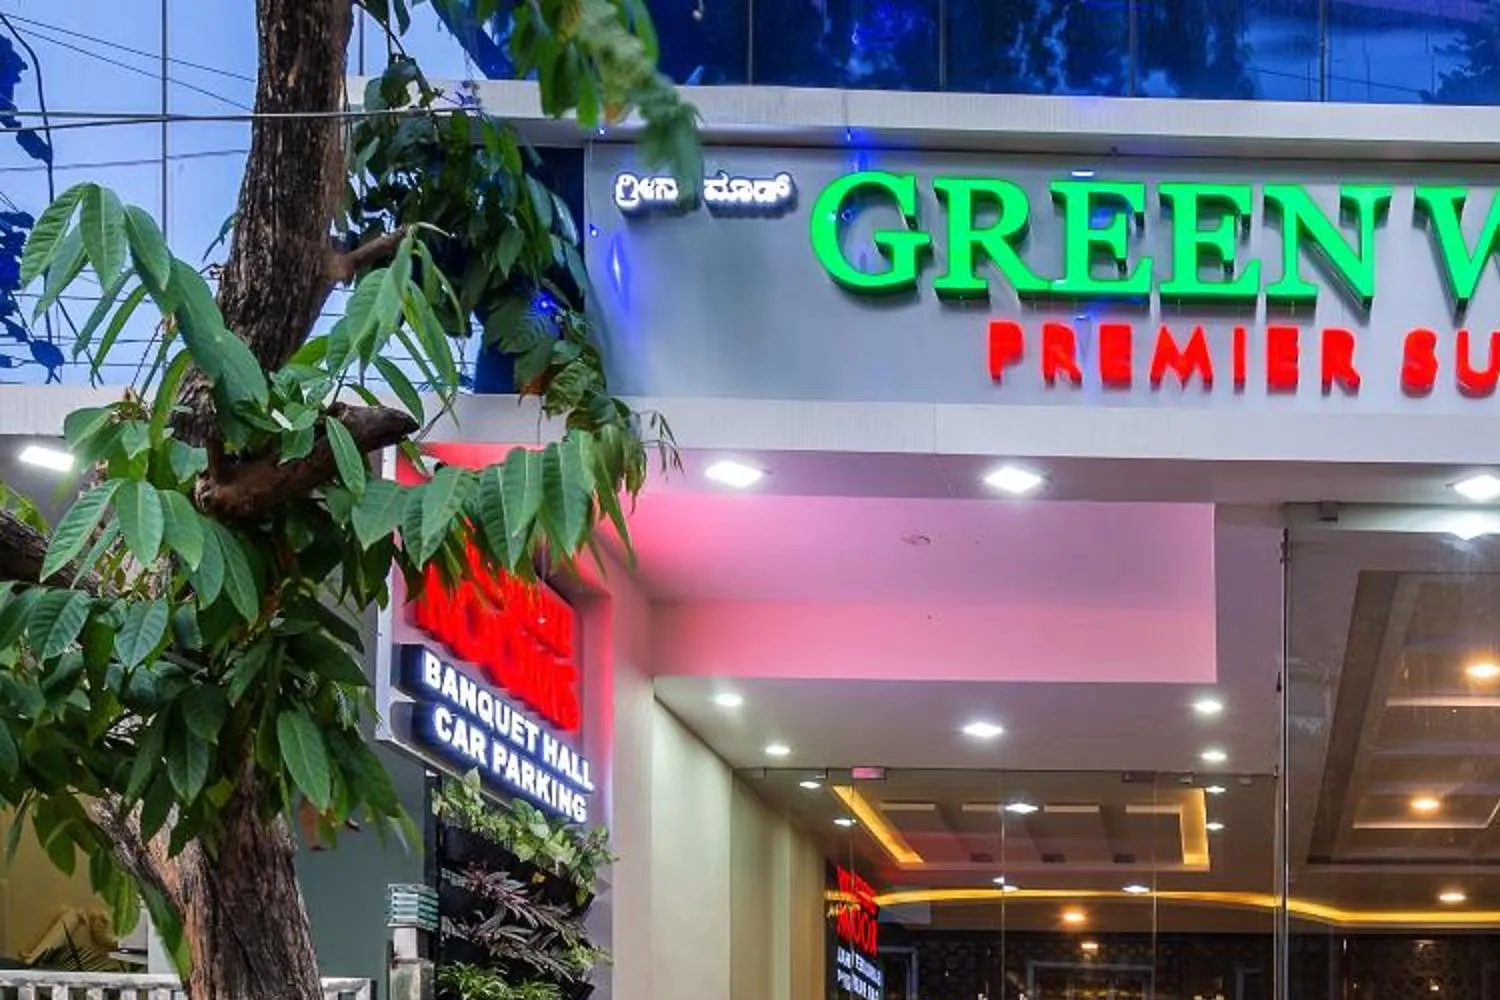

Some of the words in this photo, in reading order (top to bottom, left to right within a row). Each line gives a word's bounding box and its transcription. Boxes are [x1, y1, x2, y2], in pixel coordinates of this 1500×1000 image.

[811, 171, 1391, 310] GREEN
[987, 320, 1361, 391] PREMIER
[424, 651, 539, 753] BANQUET
[543, 732, 594, 791] HALL
[434, 706, 488, 768] CAR
[491, 742, 587, 823] PARKING
